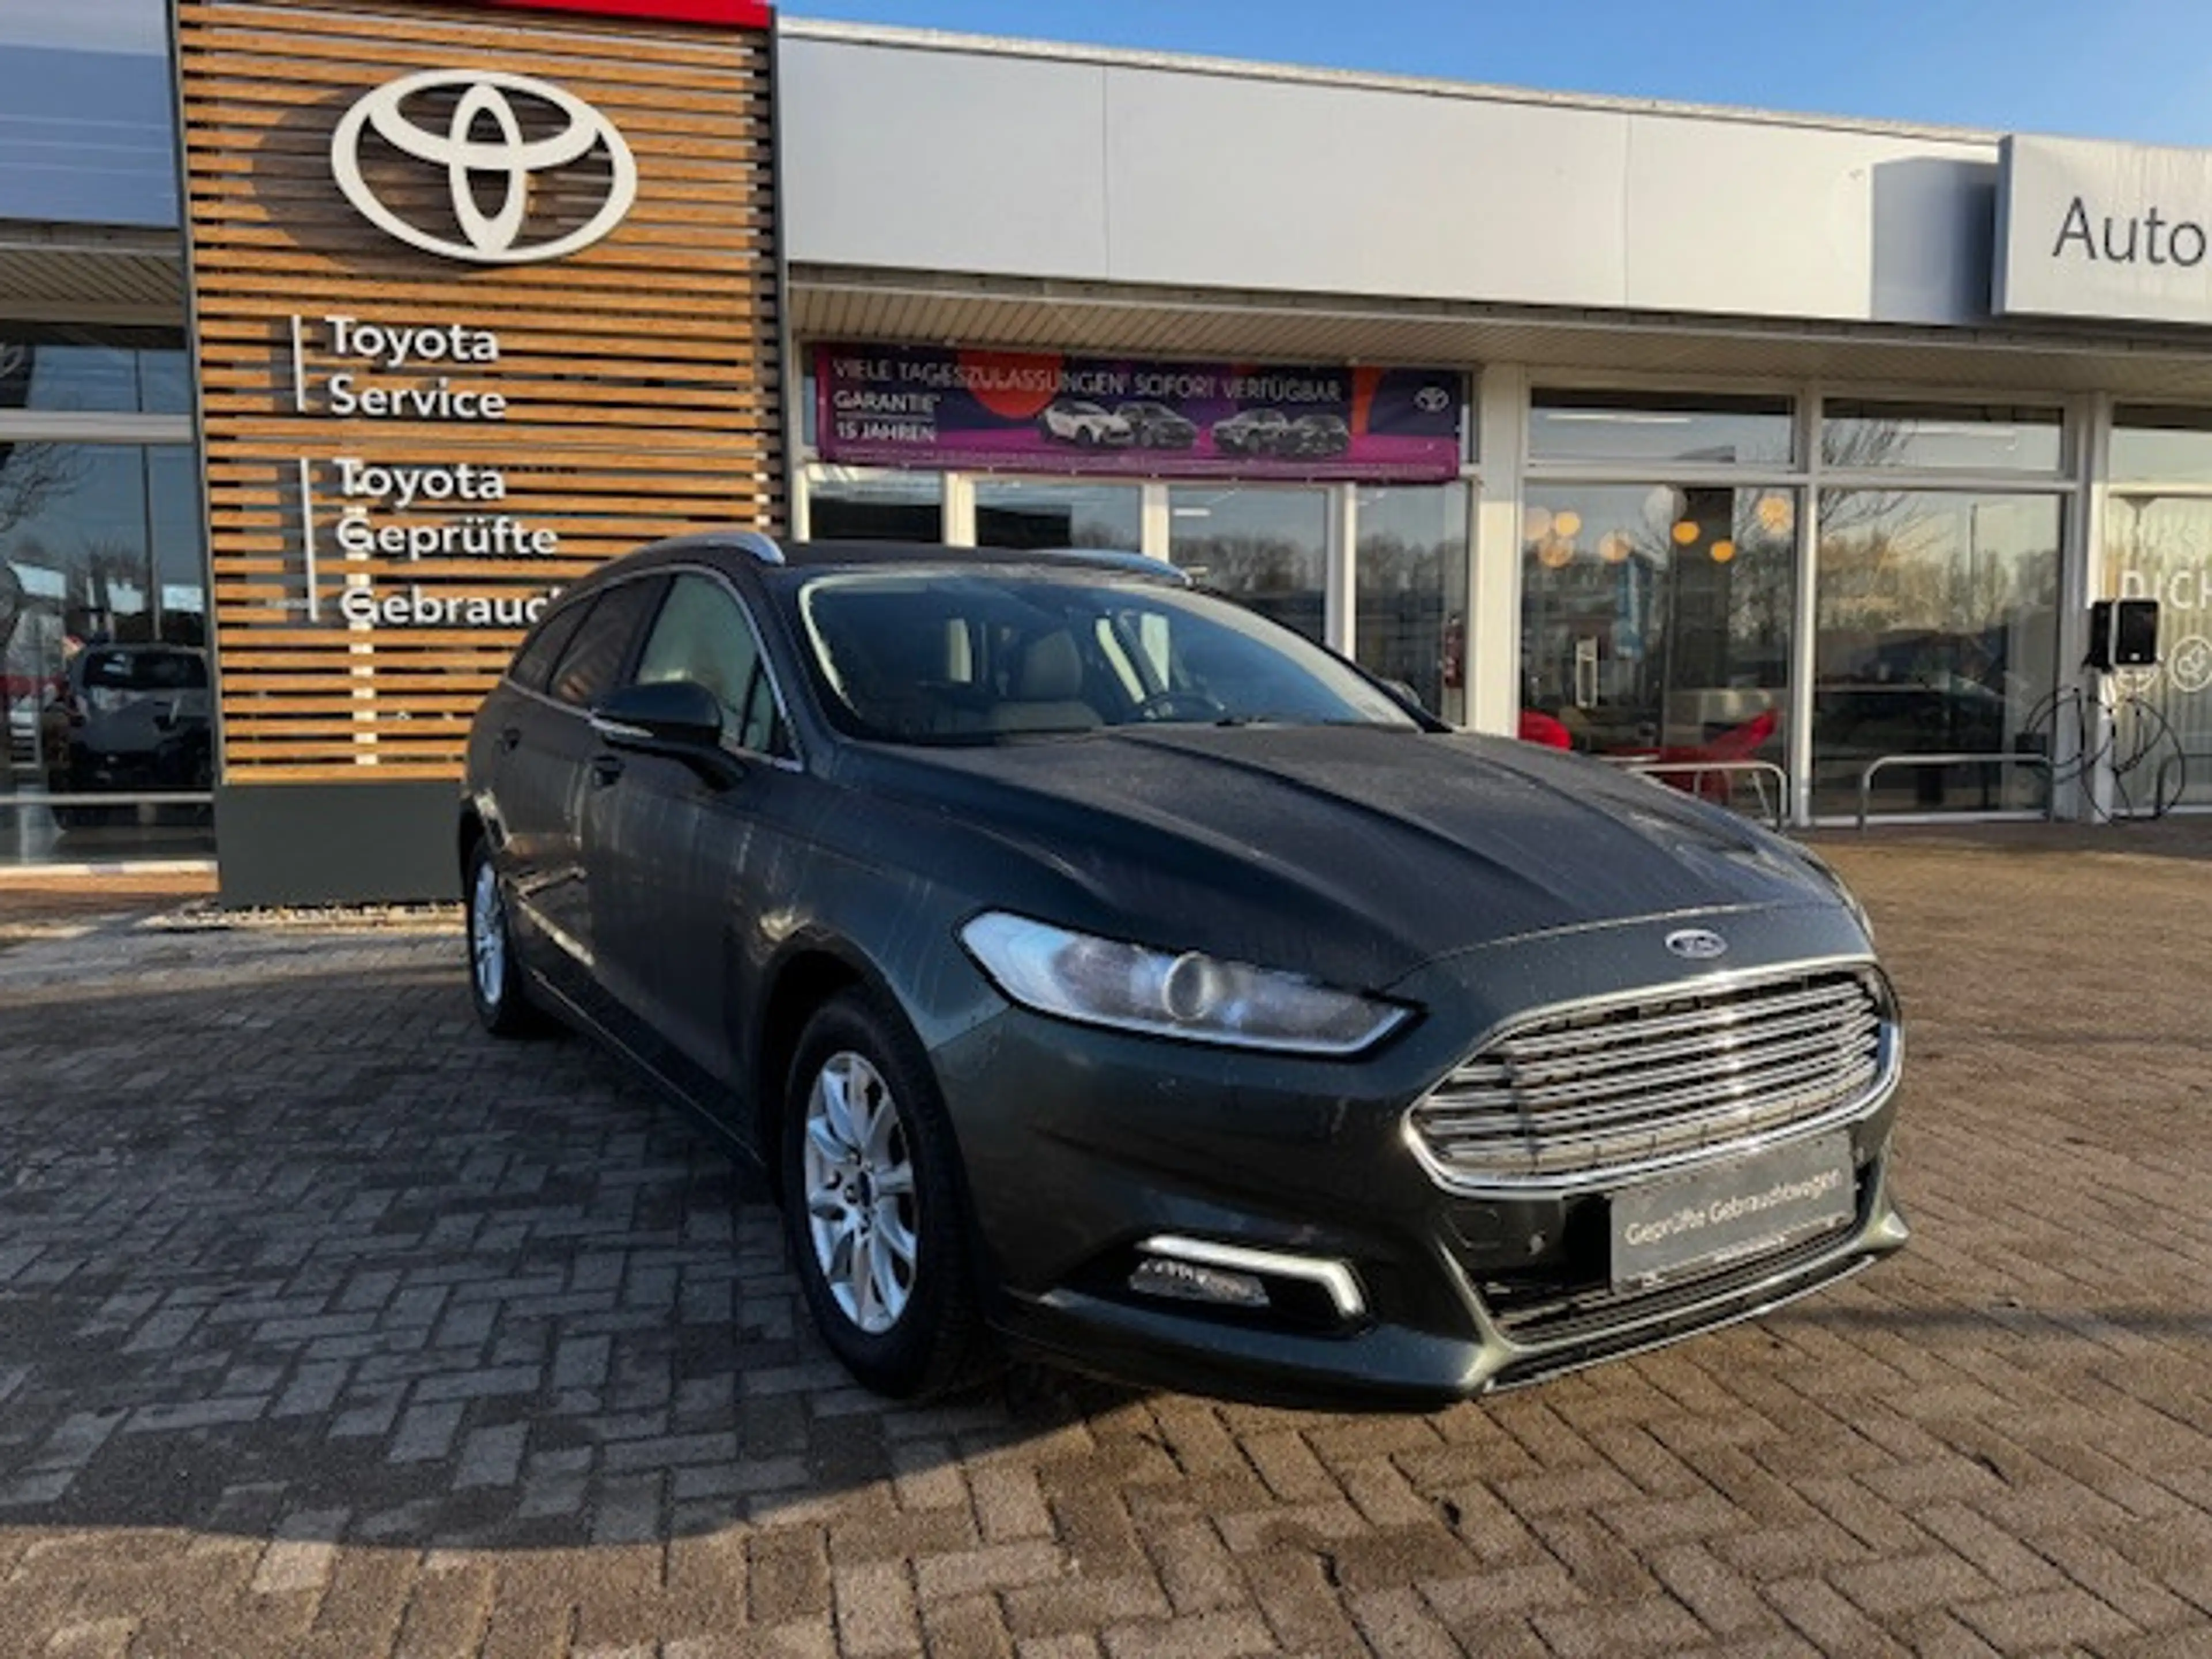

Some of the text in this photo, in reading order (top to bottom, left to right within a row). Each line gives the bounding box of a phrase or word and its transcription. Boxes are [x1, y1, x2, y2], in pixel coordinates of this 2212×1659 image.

[2052, 196, 2207, 267] Auto
[325, 315, 499, 367] Toyota
[329, 373, 507, 418] Service
[833, 358, 891, 382] VIELE
[1134, 372, 1217, 399] SOFORT
[1219, 376, 1342, 402] VERFÜGBAR
[836, 422, 857, 440] 15
[333, 457, 506, 506] Toyota
[336, 516, 559, 562] Geprüfte
[339, 585, 562, 624] Gebrauc
